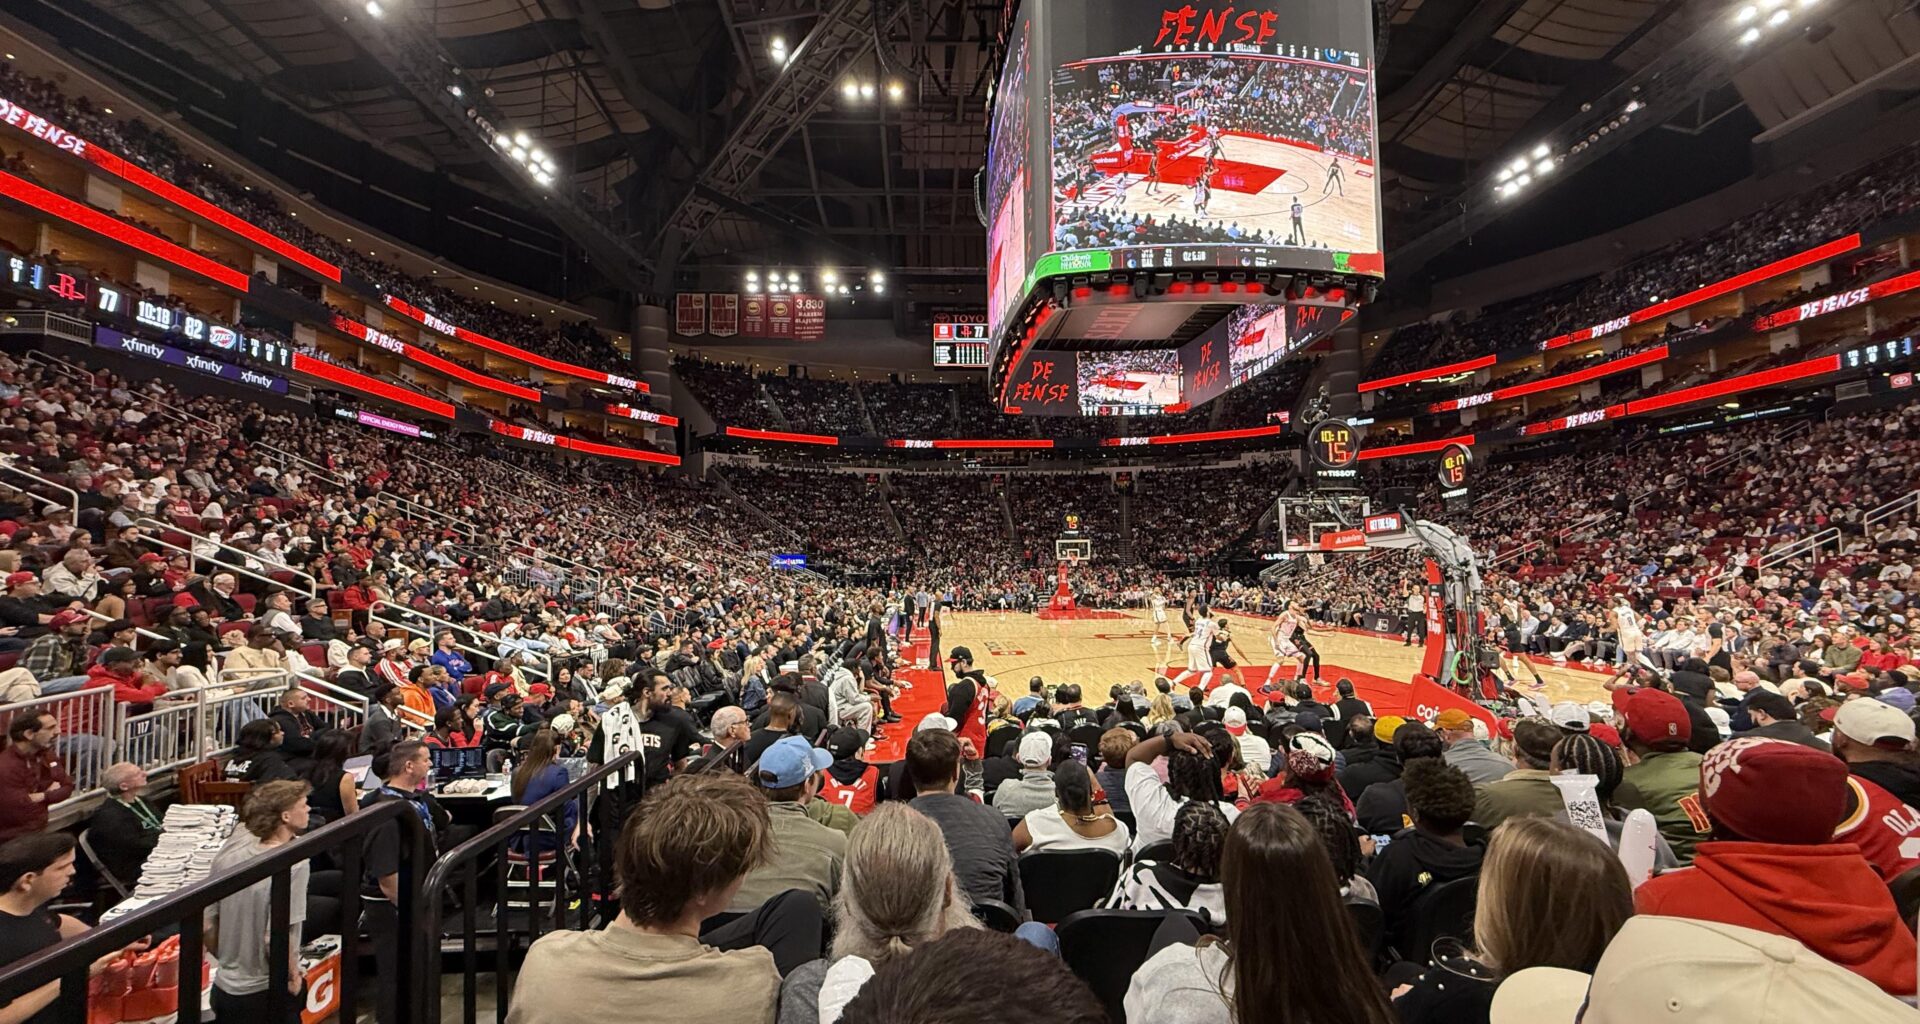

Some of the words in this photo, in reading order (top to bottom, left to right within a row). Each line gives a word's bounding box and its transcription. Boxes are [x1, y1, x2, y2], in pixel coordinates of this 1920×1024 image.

[1153, 5, 1279, 47] FENSE
[99, 287, 118, 312] 77
[139, 301, 171, 325] 10:18
[185, 316, 203, 339] 82
[974, 326, 984, 338] 77
[122, 337, 165, 359] xfinity
[186, 355, 222, 375] xfinity
[240, 371, 272, 389] xfinity
[1031, 360, 1055, 381] DE
[1013, 381, 1070, 406] FENSE
[1321, 430, 1348, 442] 10:17
[1329, 442, 1347, 462] 15
[1451, 467, 1463, 482] 15
[1416, 704, 1440, 720] coi
[137, 721, 150, 734] 117
[838, 789, 855, 808] 7
[306, 968, 334, 1013] G
